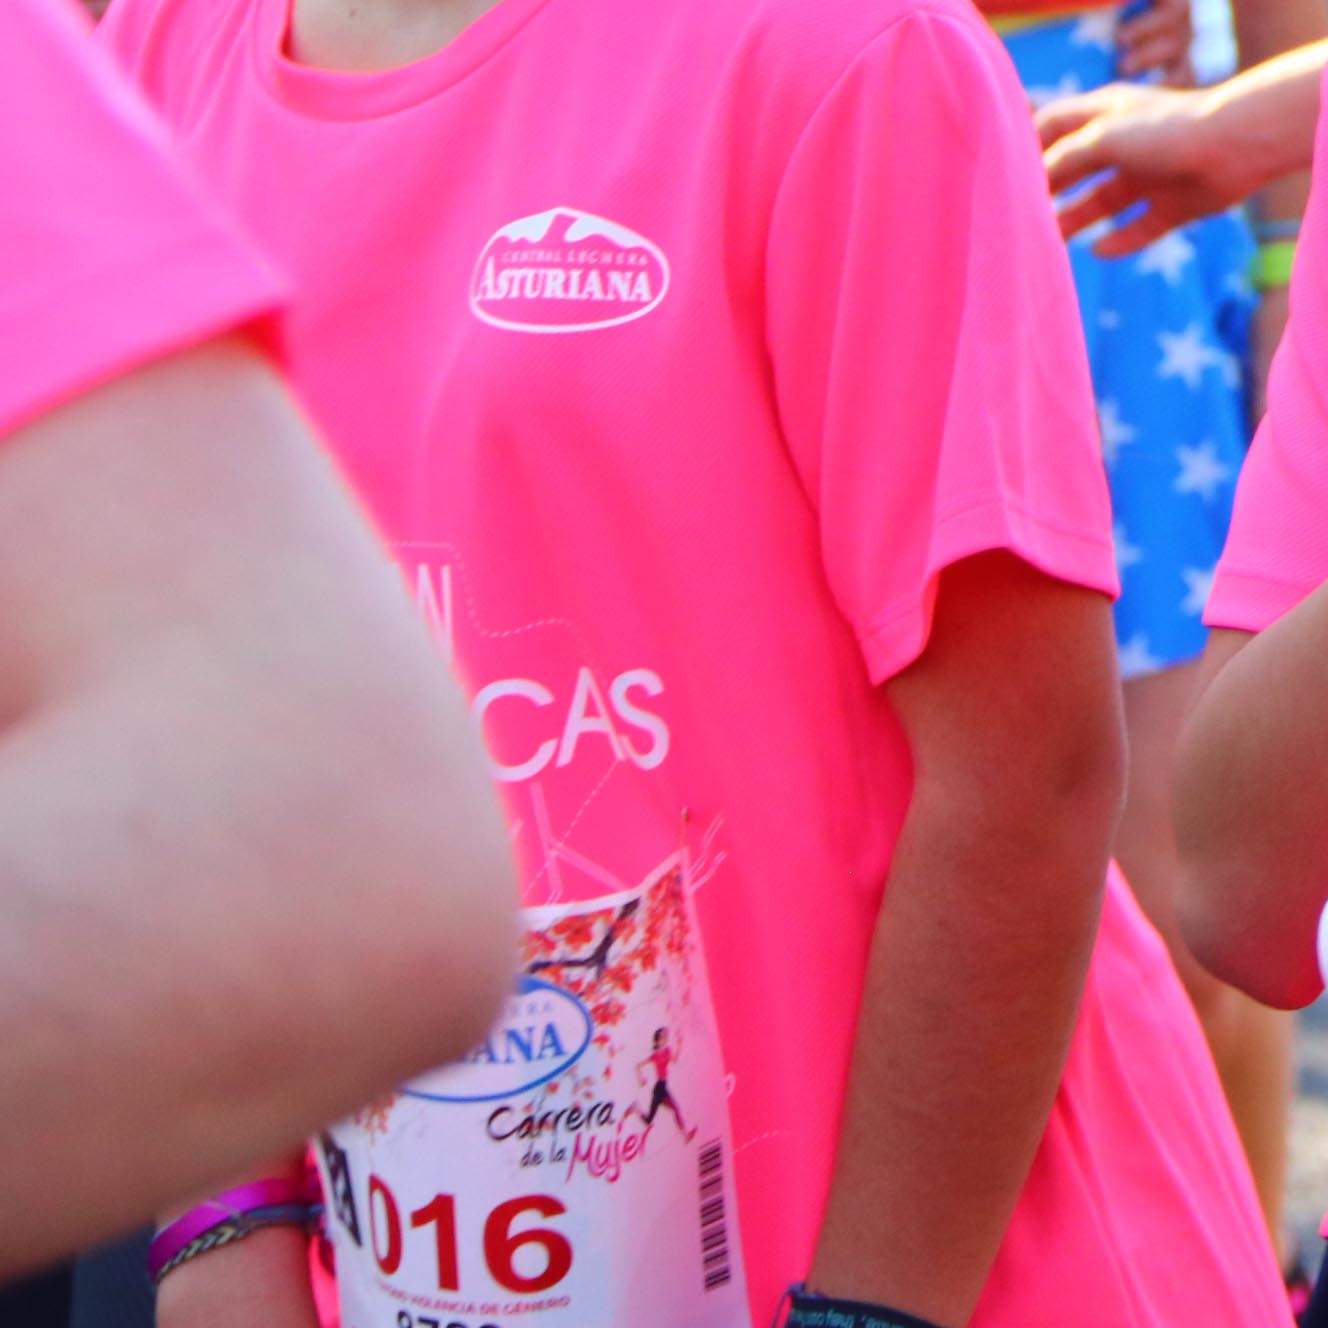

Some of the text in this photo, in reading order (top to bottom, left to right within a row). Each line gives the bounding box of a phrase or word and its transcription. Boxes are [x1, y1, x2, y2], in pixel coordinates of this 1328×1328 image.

[475, 256, 653, 302] ASTURIANA
[486, 1101, 615, 1141] Carrera
[520, 1124, 654, 1185] de la Mujer
[368, 1172, 574, 1295] 016
